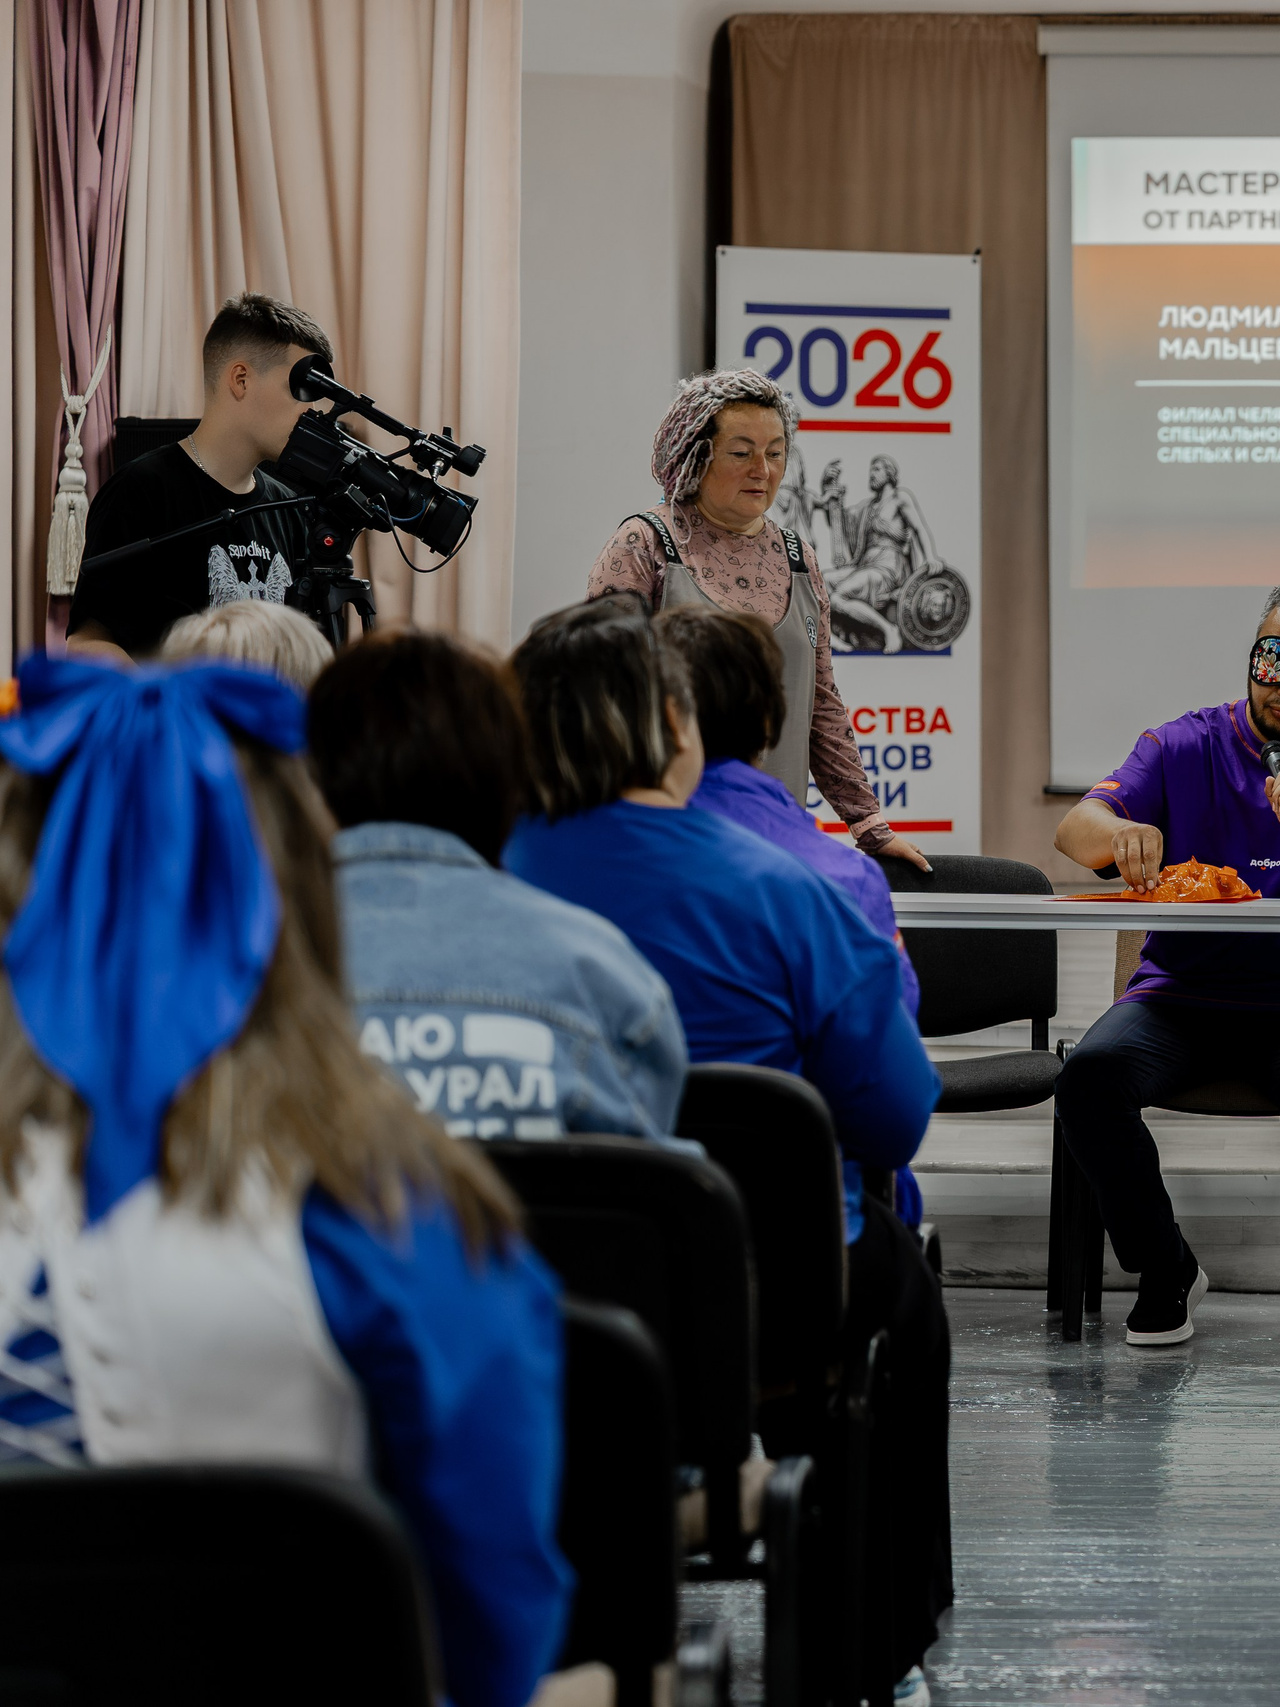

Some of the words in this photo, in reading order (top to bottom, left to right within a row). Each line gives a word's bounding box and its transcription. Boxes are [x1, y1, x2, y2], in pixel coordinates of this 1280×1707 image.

[1143, 210, 1180, 230] ОТ
[743, 325, 953, 410] 2026
[1157, 406, 1236, 423] ФИЛИАЛ
[1157, 447, 1233, 463] СЛЕПЫХ
[1235, 447, 1248, 463] И
[848, 707, 952, 734] СТВА
[404, 1064, 557, 1113] УРАЛ
